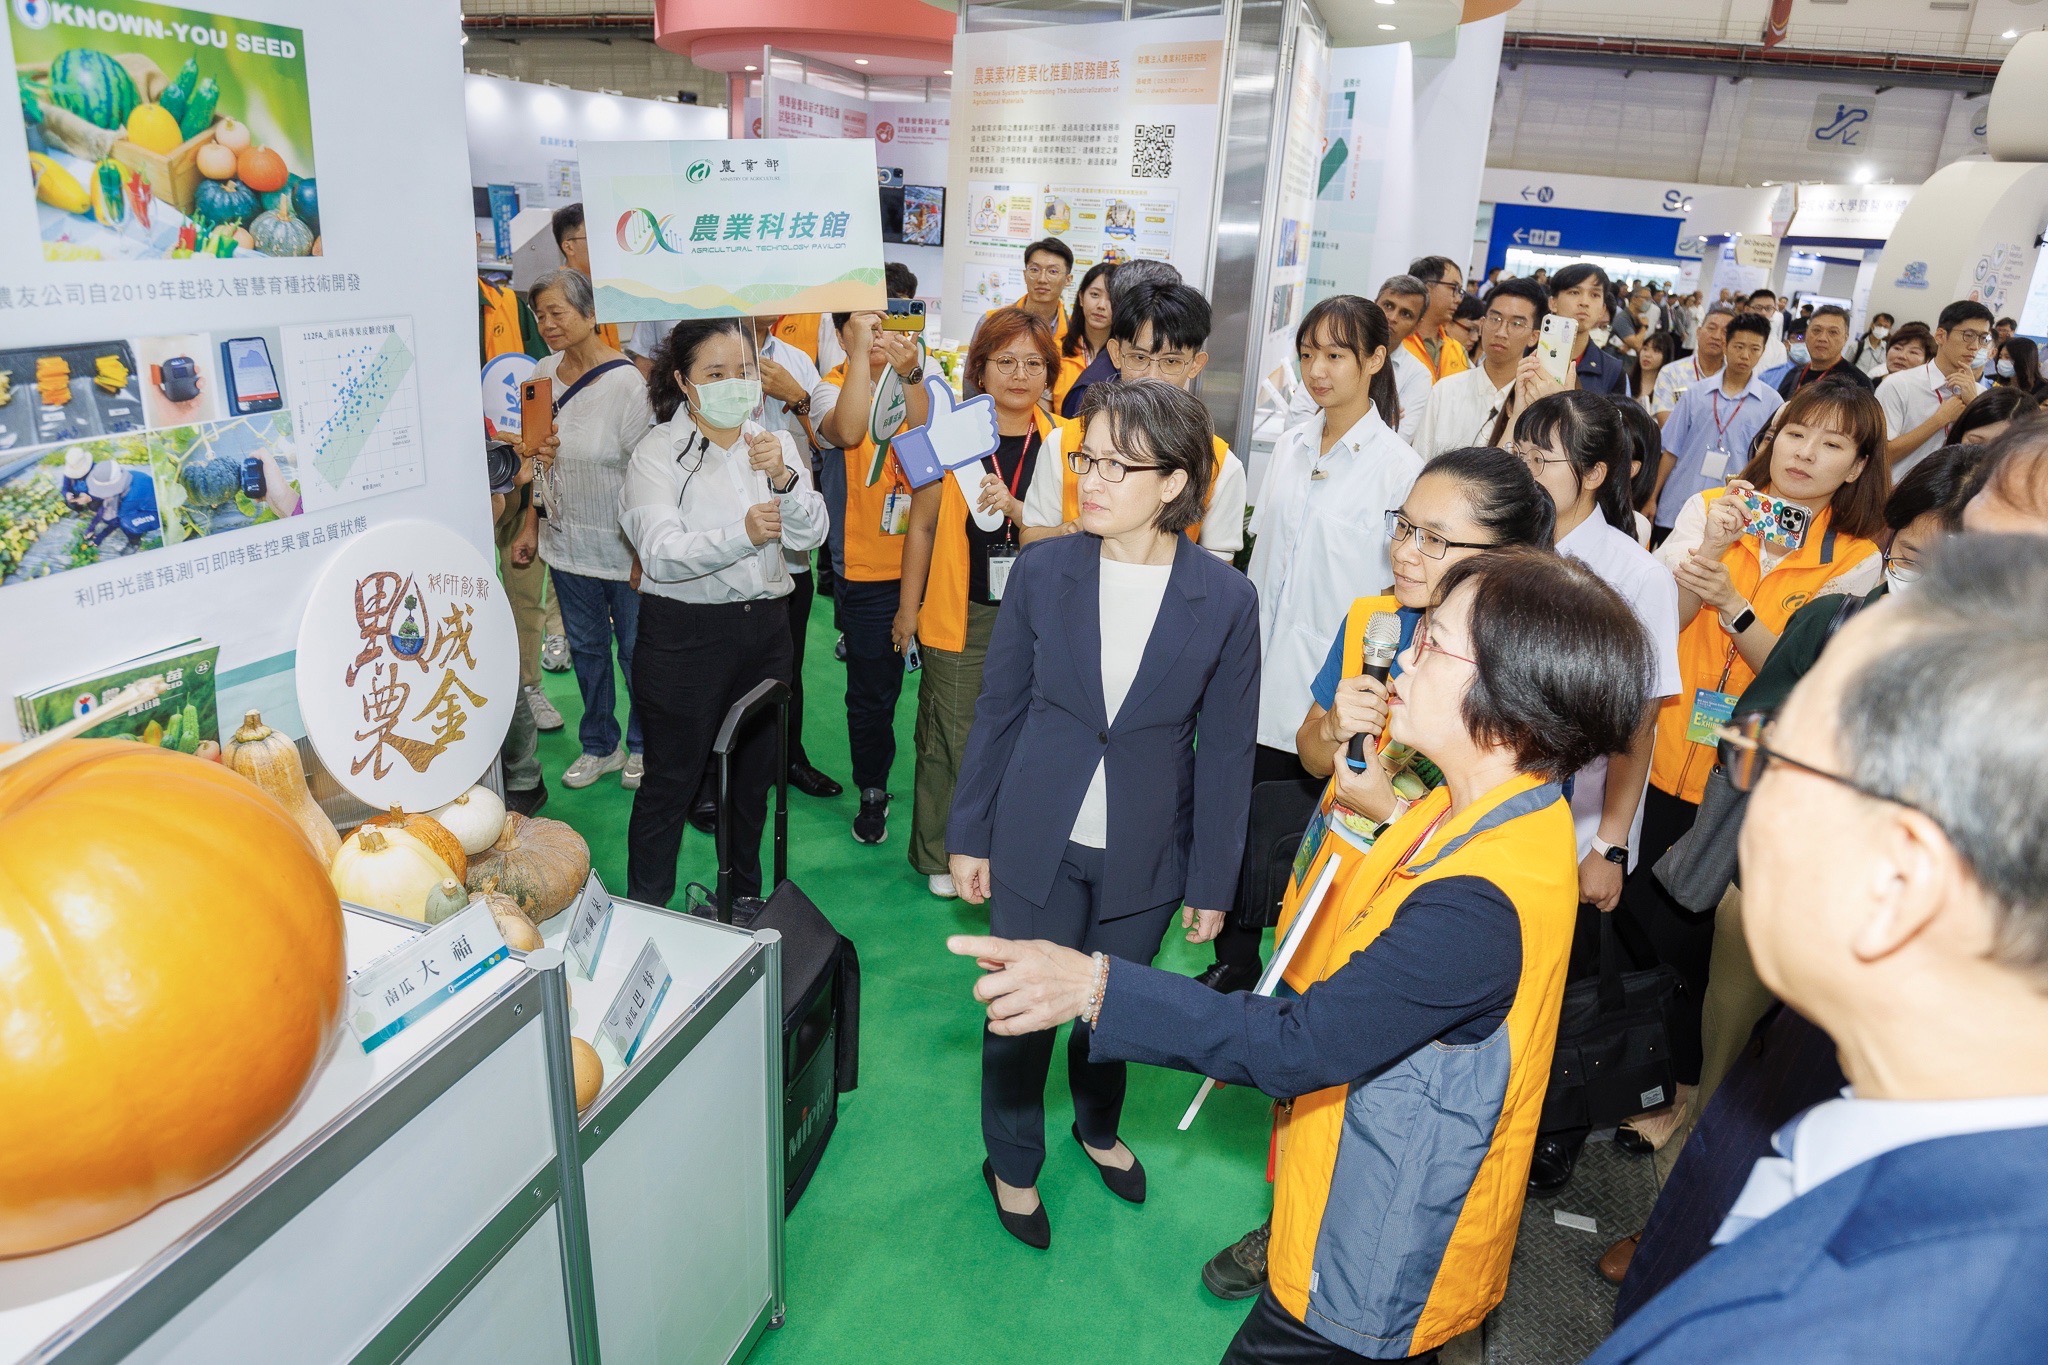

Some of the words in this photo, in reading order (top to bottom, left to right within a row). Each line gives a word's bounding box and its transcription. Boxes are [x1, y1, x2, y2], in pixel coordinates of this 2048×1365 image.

[52, 1, 228, 49] KNOWN-YOU
[235, 32, 297, 59] SEED
[973, 60, 1121, 85] 農業素材產業化推動服務體系
[1001, 90, 1019, 98] System
[1029, 88, 1055, 97] Promoting
[1067, 86, 1111, 94] Industrialization
[719, 158, 780, 173] 農業部
[689, 210, 851, 242] 農業科技館
[691, 245, 752, 254] AGRICULTURAL
[756, 244, 809, 252] TECHNOLOGY
[811, 242, 847, 250] PAVILION
[75, 514, 368, 609] 利用光譜預測可即時監控果實品質狀態
[788, 1078, 832, 1162] MIPRO
